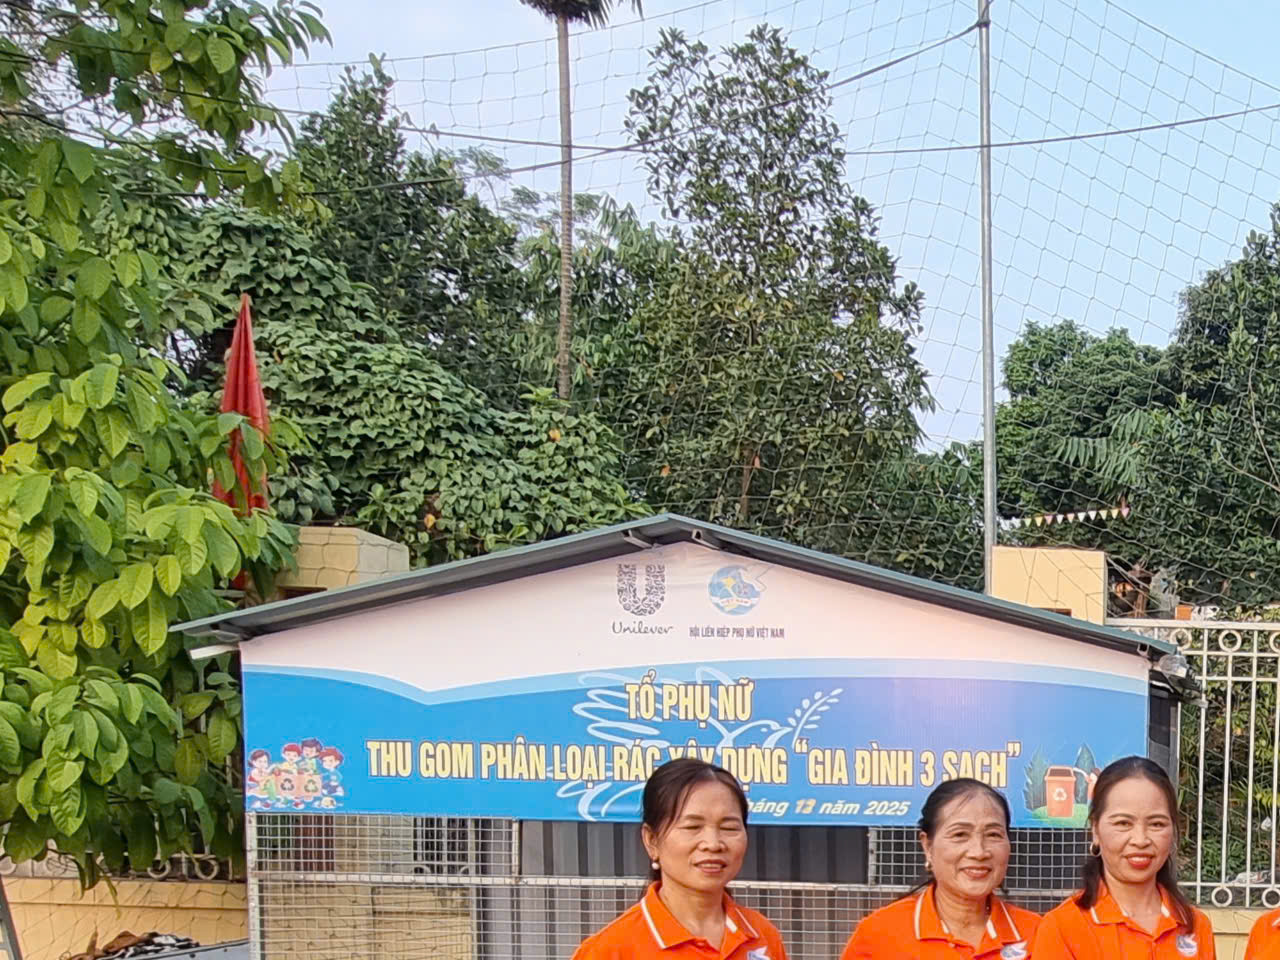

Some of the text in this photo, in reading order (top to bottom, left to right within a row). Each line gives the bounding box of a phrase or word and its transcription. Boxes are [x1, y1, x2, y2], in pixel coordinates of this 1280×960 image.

[612, 620, 674, 635] Unilever
[770, 627, 785, 639] NAM
[625, 669, 755, 729] TỔ PHỤ NỮ
[366, 740, 412, 778] THU
[418, 741, 474, 779] GOM
[480, 735, 548, 781] PHÂN
[552, 743, 606, 789] LOẠI
[612, 738, 661, 782] RÁC
[721, 743, 787, 792] DỰNG
[854, 741, 914, 788] ĐÌNH
[919, 750, 937, 788] 3
[747, 798, 789, 817] háng
[819, 799, 860, 816] năm
[863, 800, 911, 816] 2025
